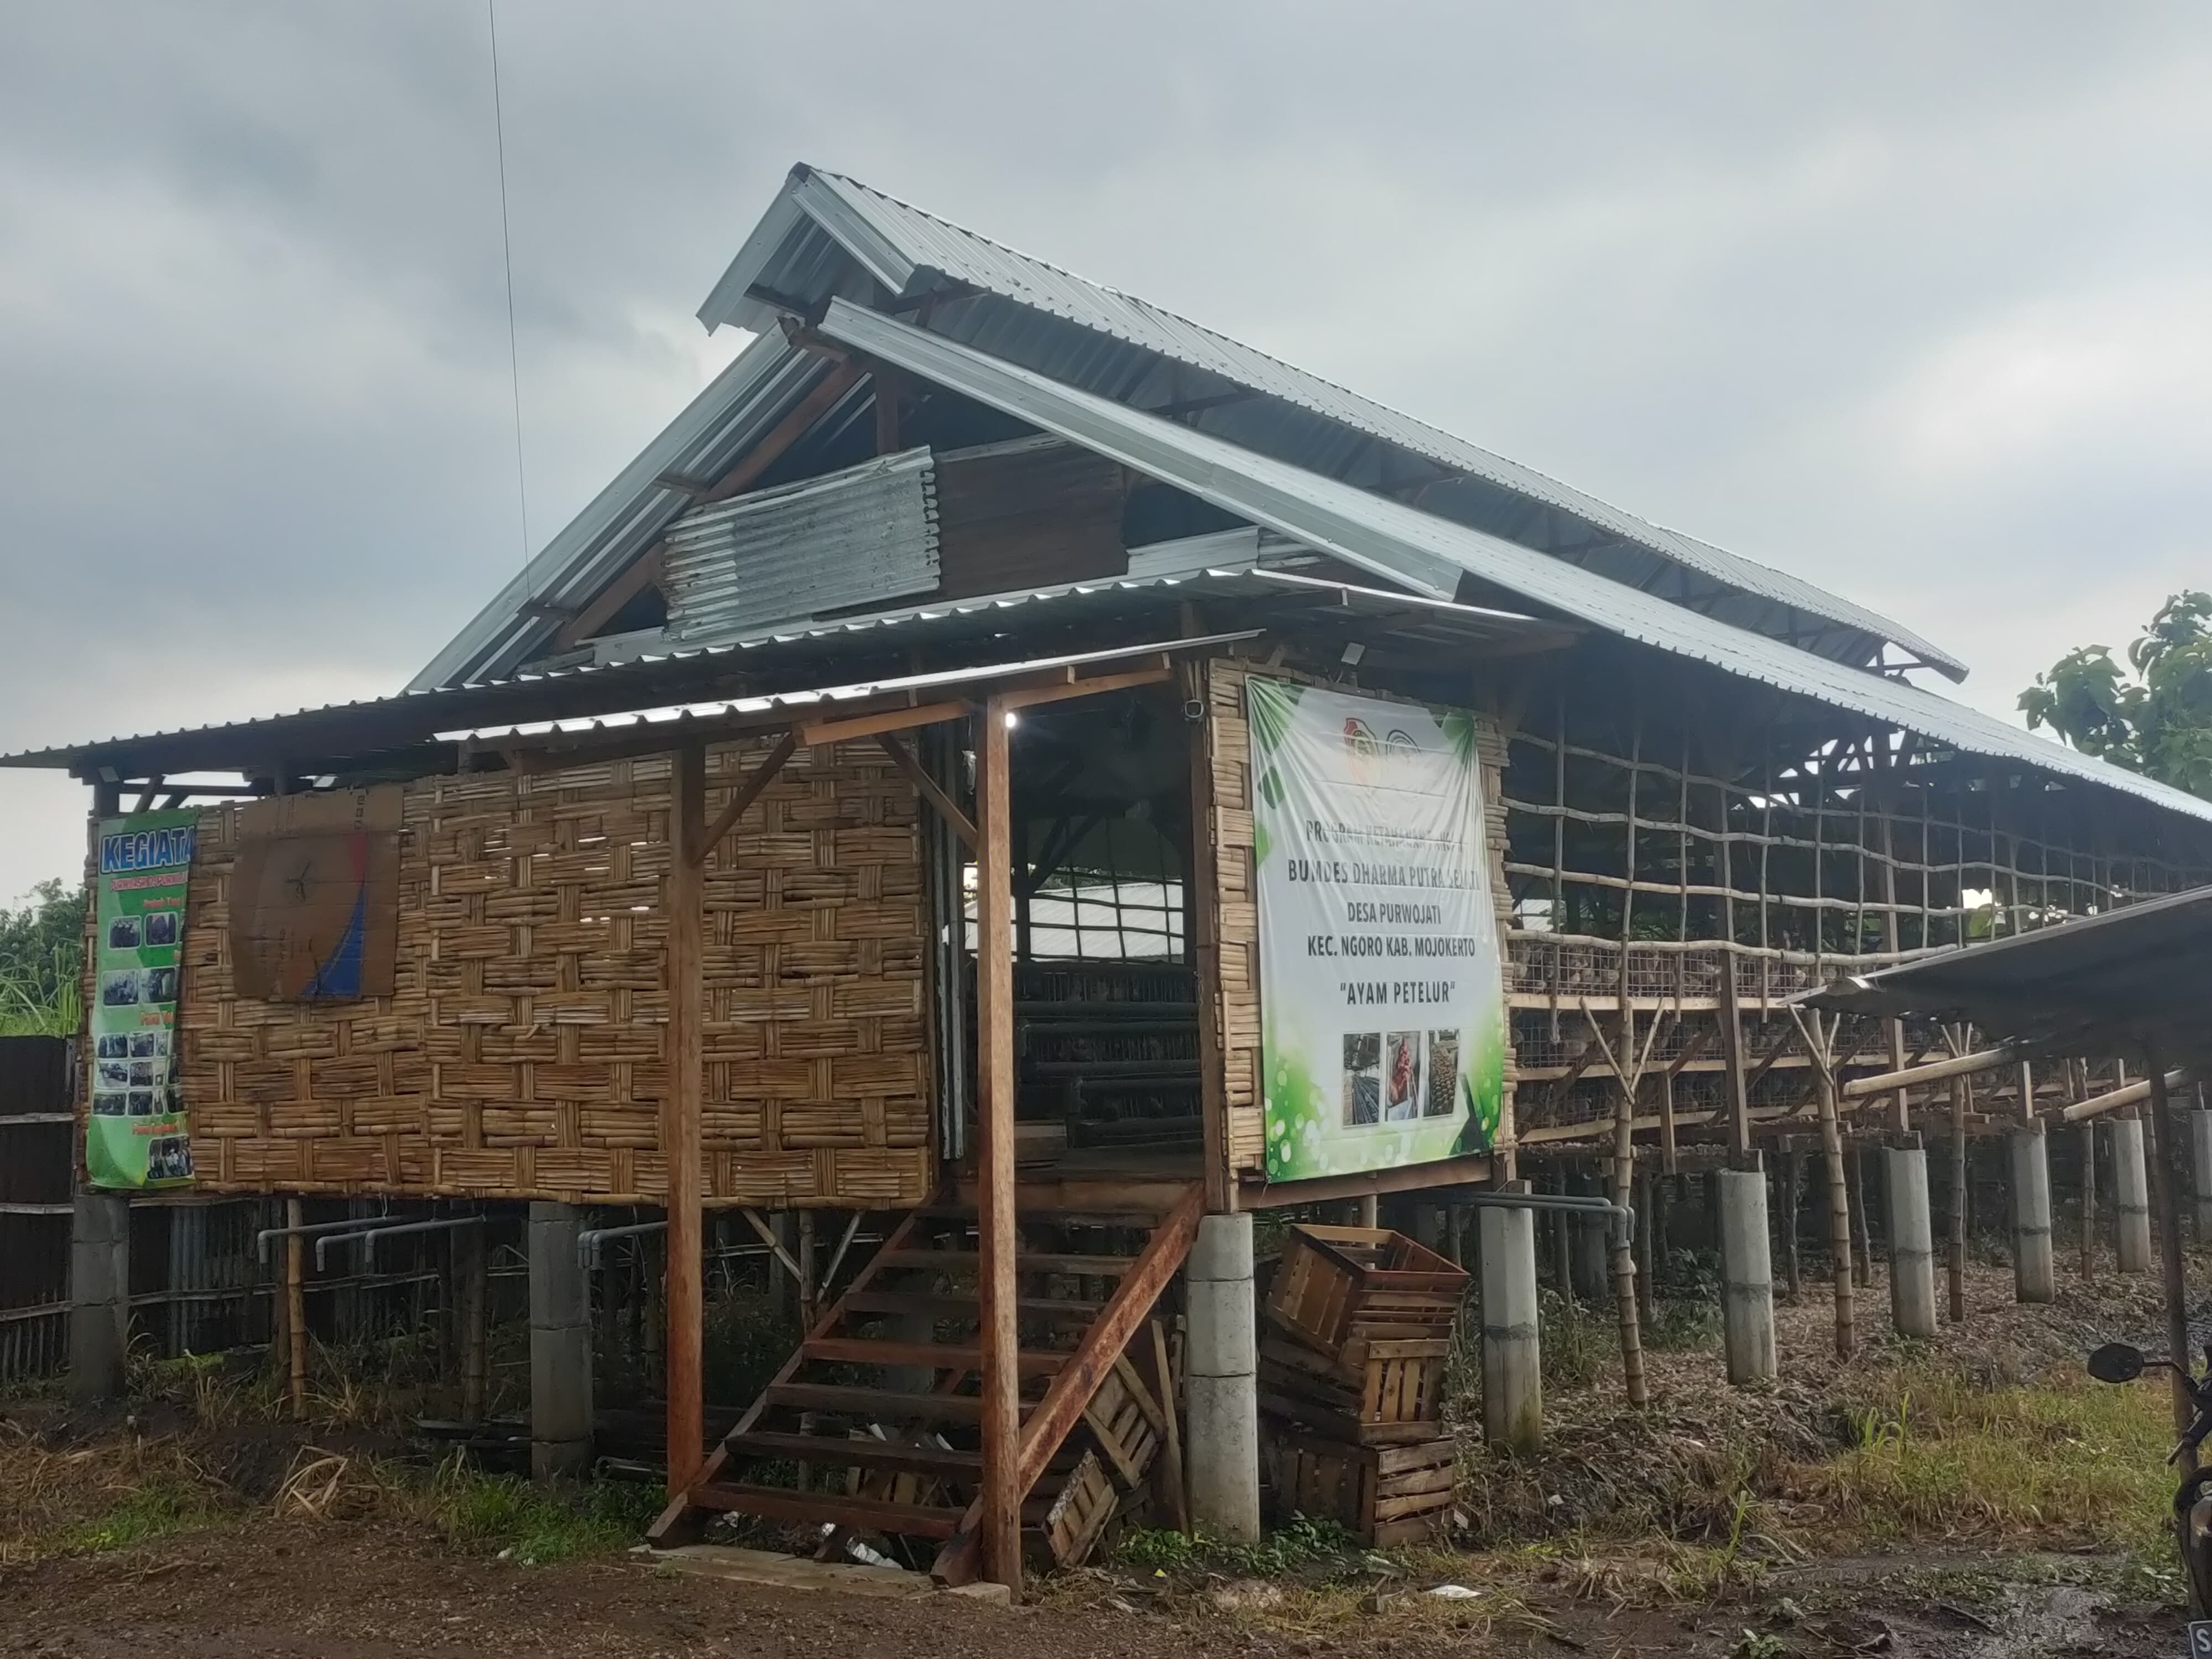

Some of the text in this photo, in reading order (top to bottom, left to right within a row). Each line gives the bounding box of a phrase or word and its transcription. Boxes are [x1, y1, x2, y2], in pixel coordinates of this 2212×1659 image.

[1288, 859, 1348, 883] BUMDES
[1353, 863, 1406, 886] DHARMA
[1409, 866, 1445, 888] PUTRA
[1347, 902, 1441, 924] DESA PURWOJATI
[1308, 935, 1475, 957] KEC. NGORO KAB. MOJOKERTO
[1340, 981, 1455, 1005] "AYAM PETELUR"
[2196, 1628, 2211, 1652] S
